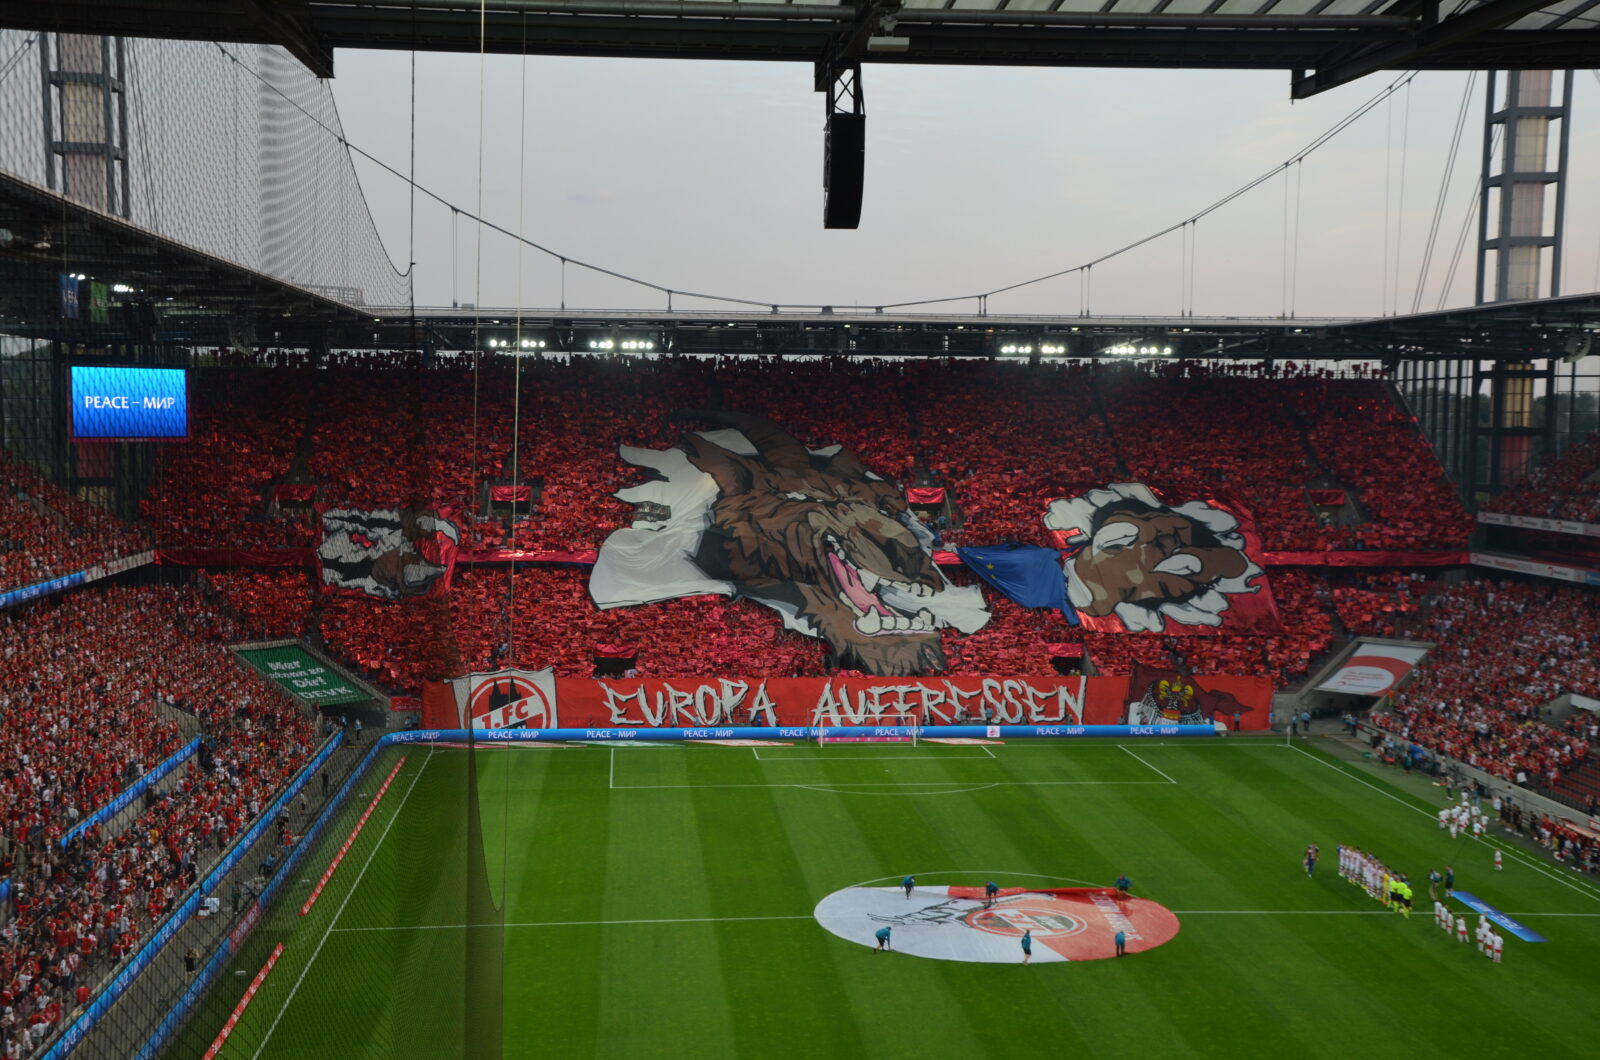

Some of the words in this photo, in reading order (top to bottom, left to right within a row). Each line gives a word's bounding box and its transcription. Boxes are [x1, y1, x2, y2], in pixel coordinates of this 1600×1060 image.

[85, 396, 129, 408] PEACE
[143, 396, 175, 409] МИР
[298, 686, 353, 699] DEVK
[598, 678, 777, 727] EUROPA
[811, 675, 1087, 727] AUFFRESSEN
[488, 731, 513, 739] PEACE
[587, 730, 611, 738] PEACE
[683, 729, 708, 737] PEACE
[780, 729, 803, 737] PEACE
[875, 728, 899, 736] PEACE
[1036, 727, 1060, 735] PEACE
[392, 733, 415, 742] PEACE
